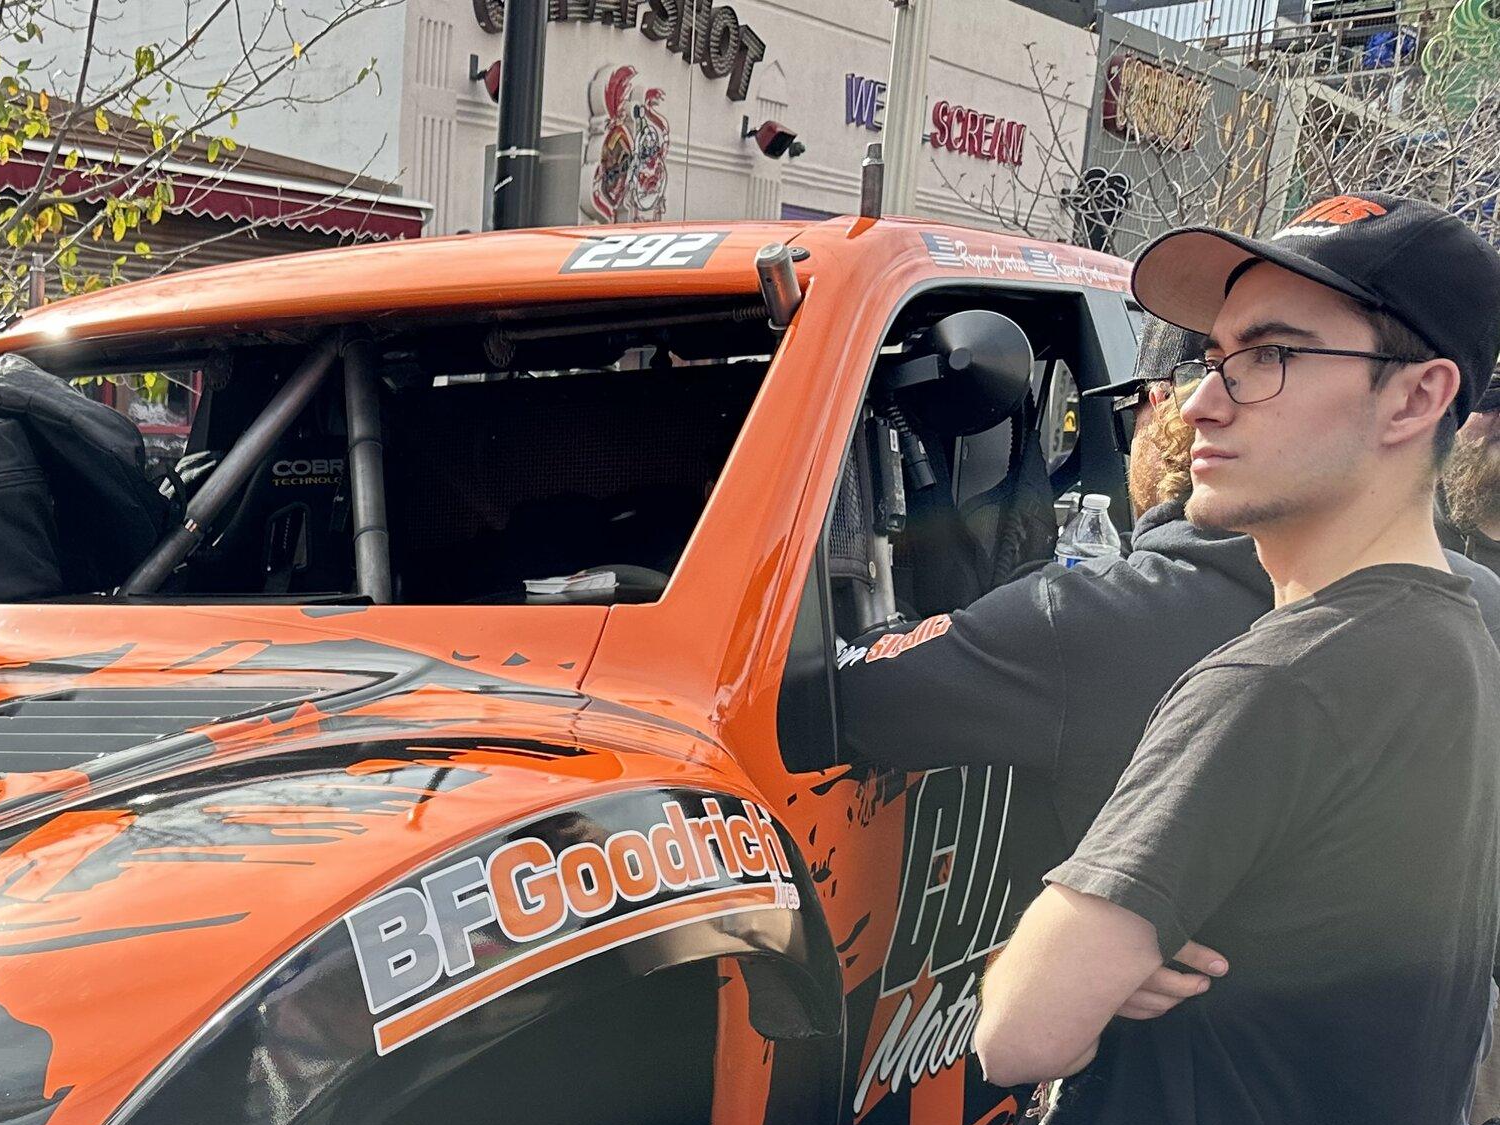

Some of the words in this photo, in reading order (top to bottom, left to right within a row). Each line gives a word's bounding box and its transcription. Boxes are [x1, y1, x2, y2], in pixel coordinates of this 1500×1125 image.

[845, 73, 886, 131] WE
[930, 101, 1027, 166] SCREAM
[570, 233, 718, 269] 292
[273, 459, 344, 477] COBR
[343, 797, 792, 1016] BFGoodrich
